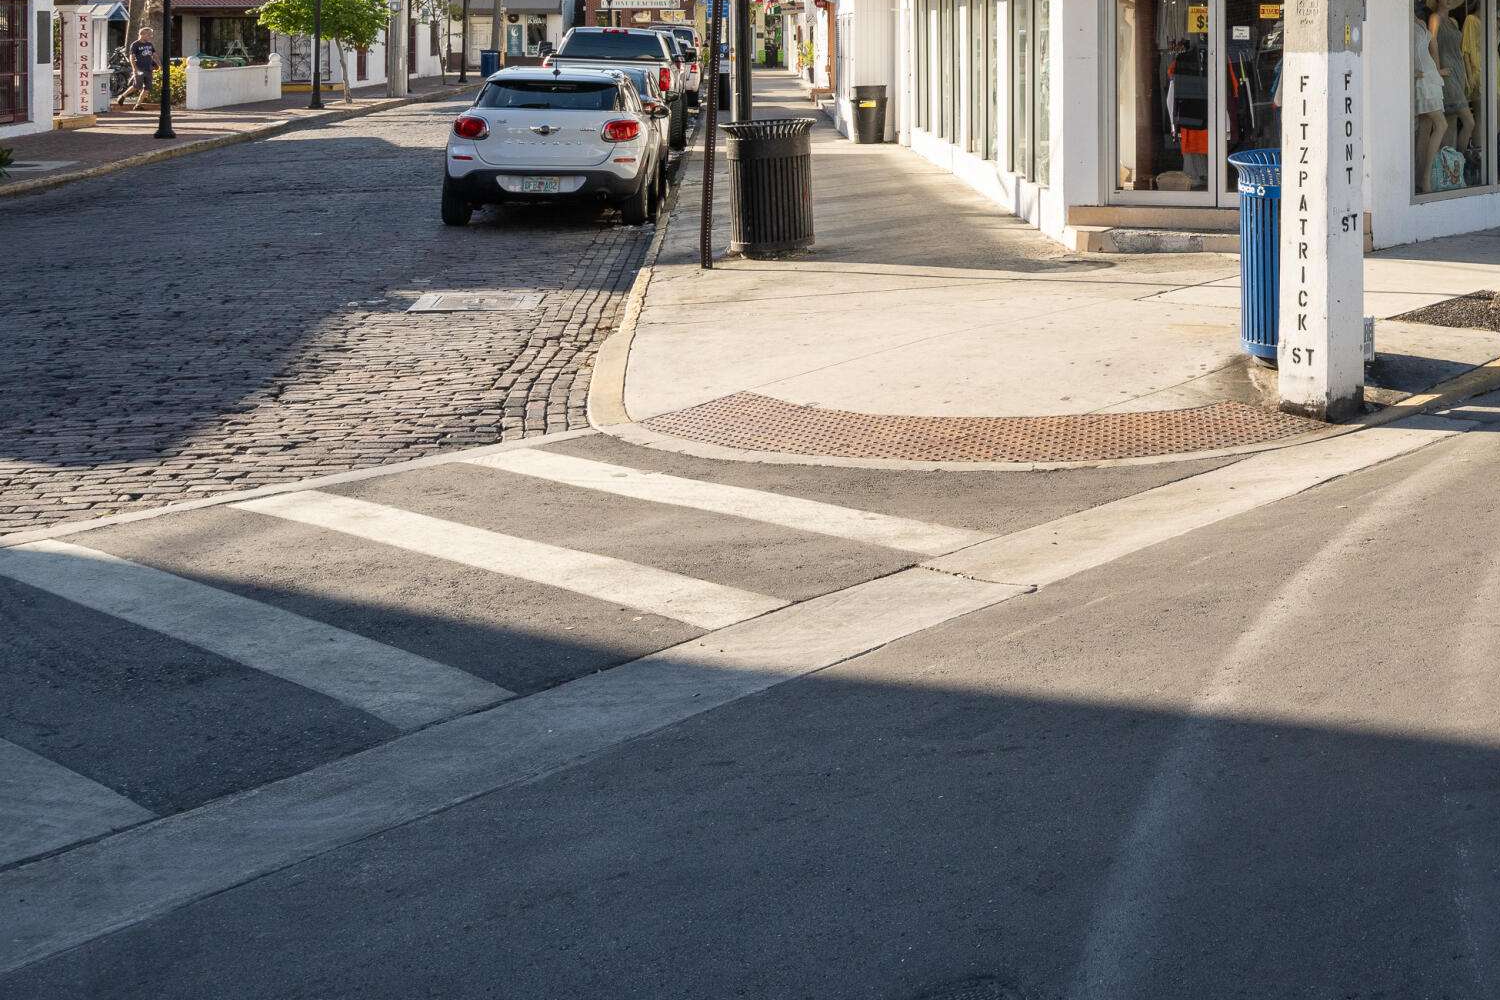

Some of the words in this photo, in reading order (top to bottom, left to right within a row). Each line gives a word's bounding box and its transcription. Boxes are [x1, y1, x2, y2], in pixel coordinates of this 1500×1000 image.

[79, 15, 88, 47] KINO
[80, 55, 88, 112] SANDALS
[1344, 73, 1353, 184] FRONT
[1298, 75, 1309, 331] FITZPATRICK
[1341, 213, 1357, 232] ST
[1292, 347, 1314, 366] ST
